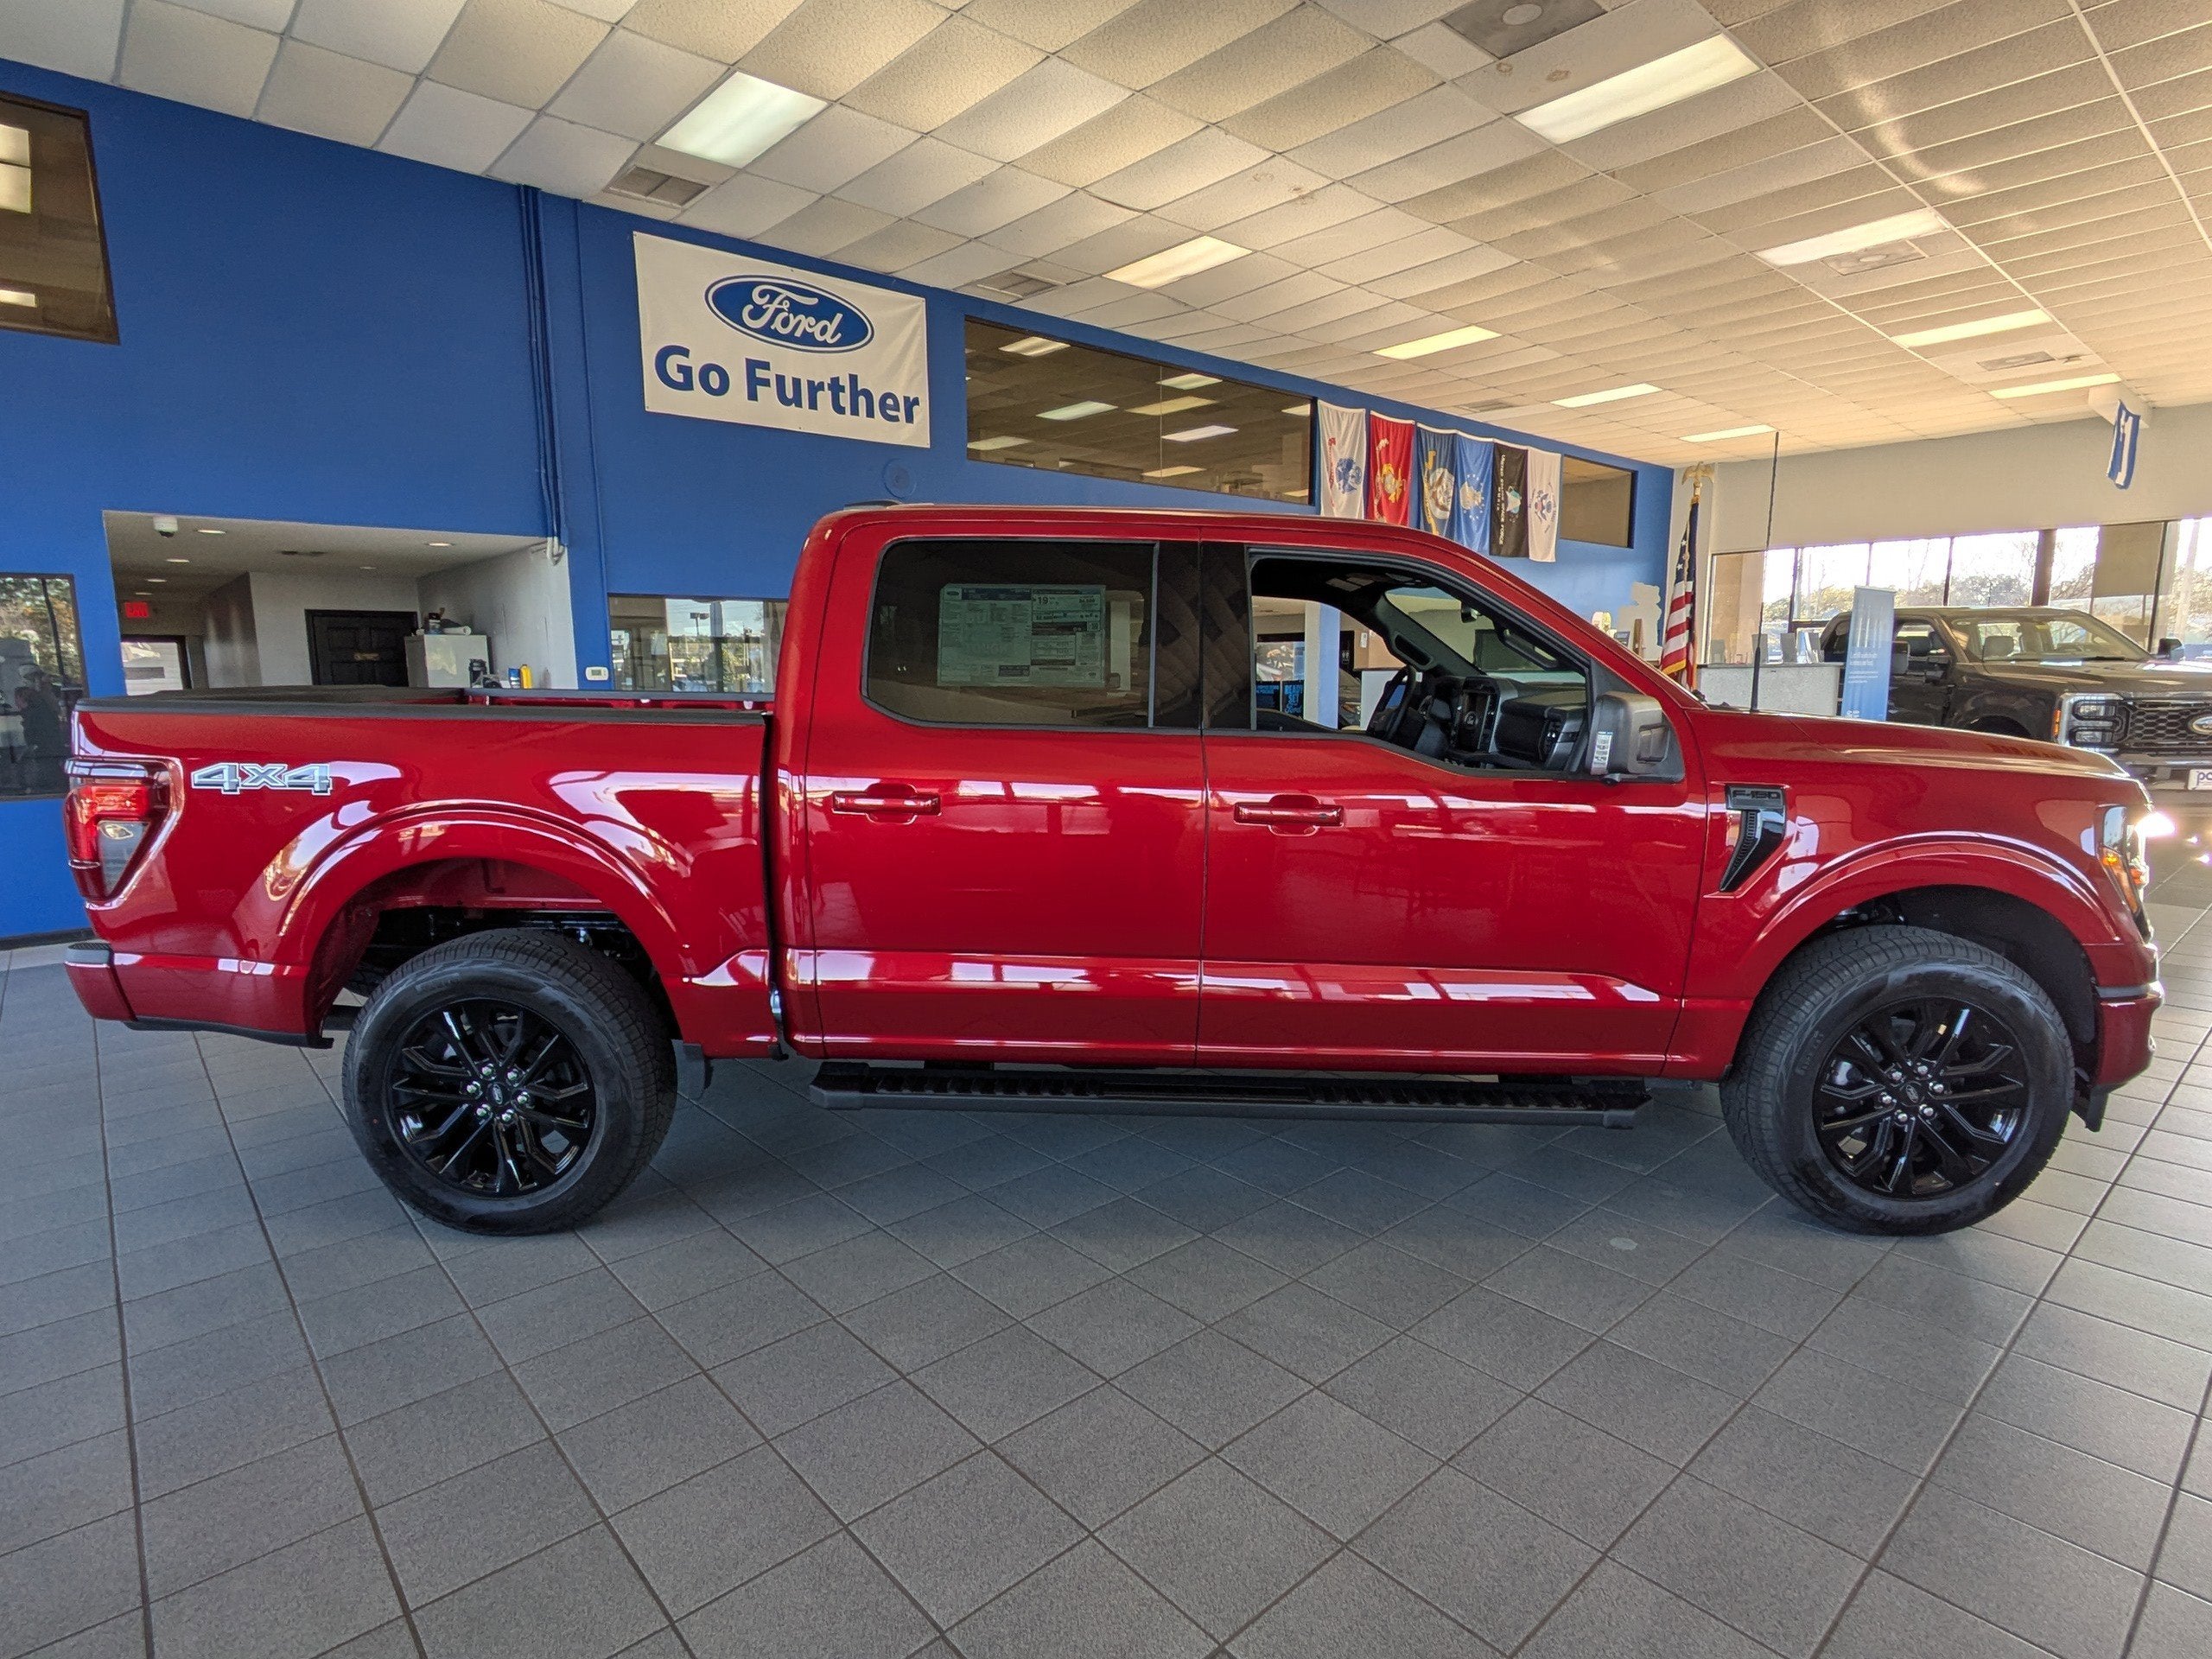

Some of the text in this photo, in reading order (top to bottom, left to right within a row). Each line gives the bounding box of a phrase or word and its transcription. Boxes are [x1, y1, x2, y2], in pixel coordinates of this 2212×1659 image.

[742, 284, 842, 345] Ford
[654, 345, 920, 424] Go Further
[1732, 789, 1781, 799] F-150
